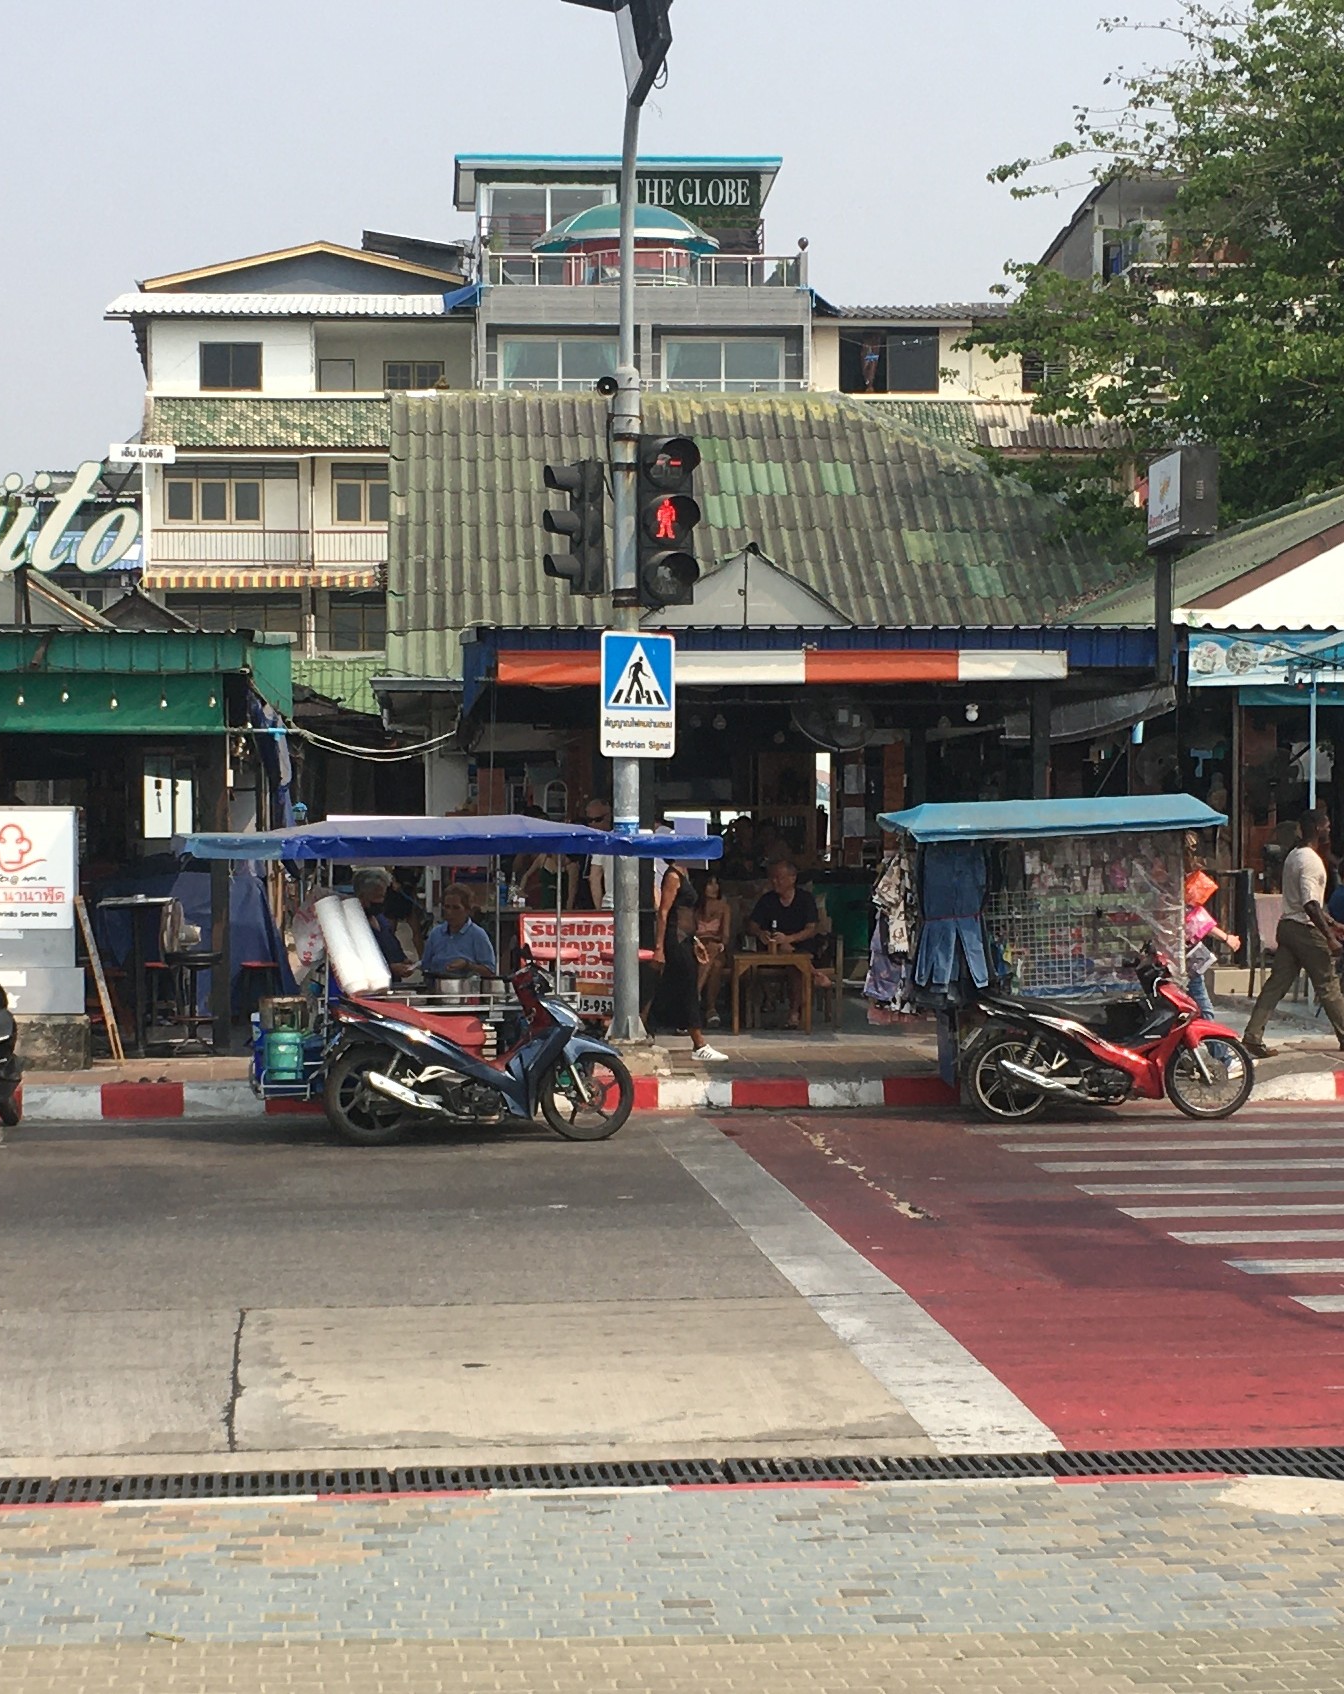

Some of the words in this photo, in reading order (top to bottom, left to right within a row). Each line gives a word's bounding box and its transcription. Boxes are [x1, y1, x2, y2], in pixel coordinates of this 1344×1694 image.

[678, 177, 750, 206] GLOBE
[606, 740, 646, 749] Pedestrian
[648, 741, 671, 751] Signal
